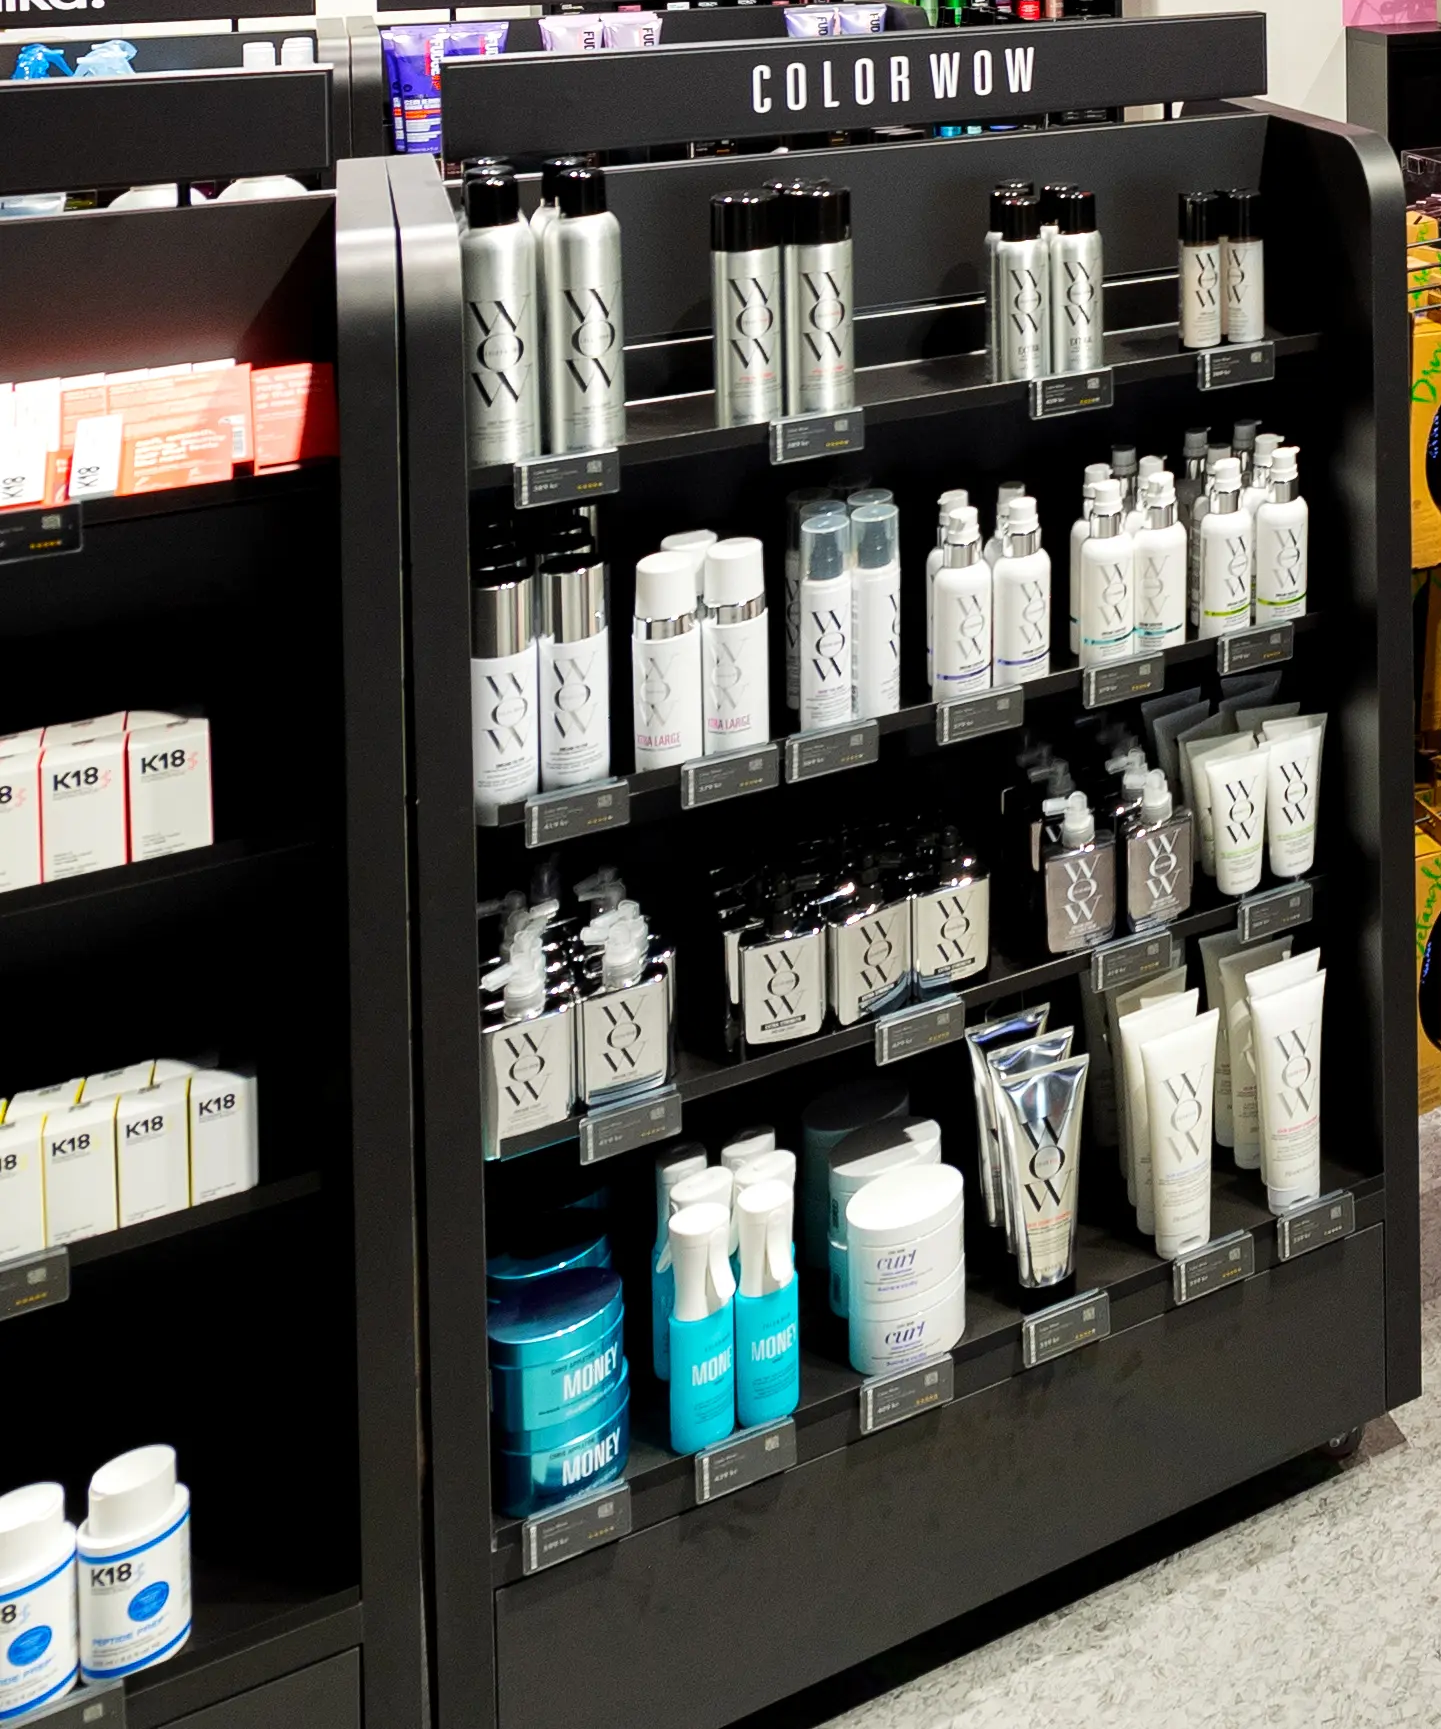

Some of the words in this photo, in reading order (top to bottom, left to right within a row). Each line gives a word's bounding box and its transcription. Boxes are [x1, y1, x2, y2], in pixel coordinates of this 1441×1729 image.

[753, 56, 909, 114] COLOR
[929, 46, 1037, 100] WOW
[724, 714, 751, 731] LARGE
[653, 732, 681, 746] LARGE
[141, 748, 187, 775] K18
[52, 766, 99, 792] K18
[199, 1093, 236, 1116] K18
[125, 1115, 164, 1139] K18
[52, 1133, 91, 1157] K18
[563, 1341, 618, 1401] MONEY
[562, 1427, 621, 1487] MONEY
[90, 1562, 133, 1588] K18
